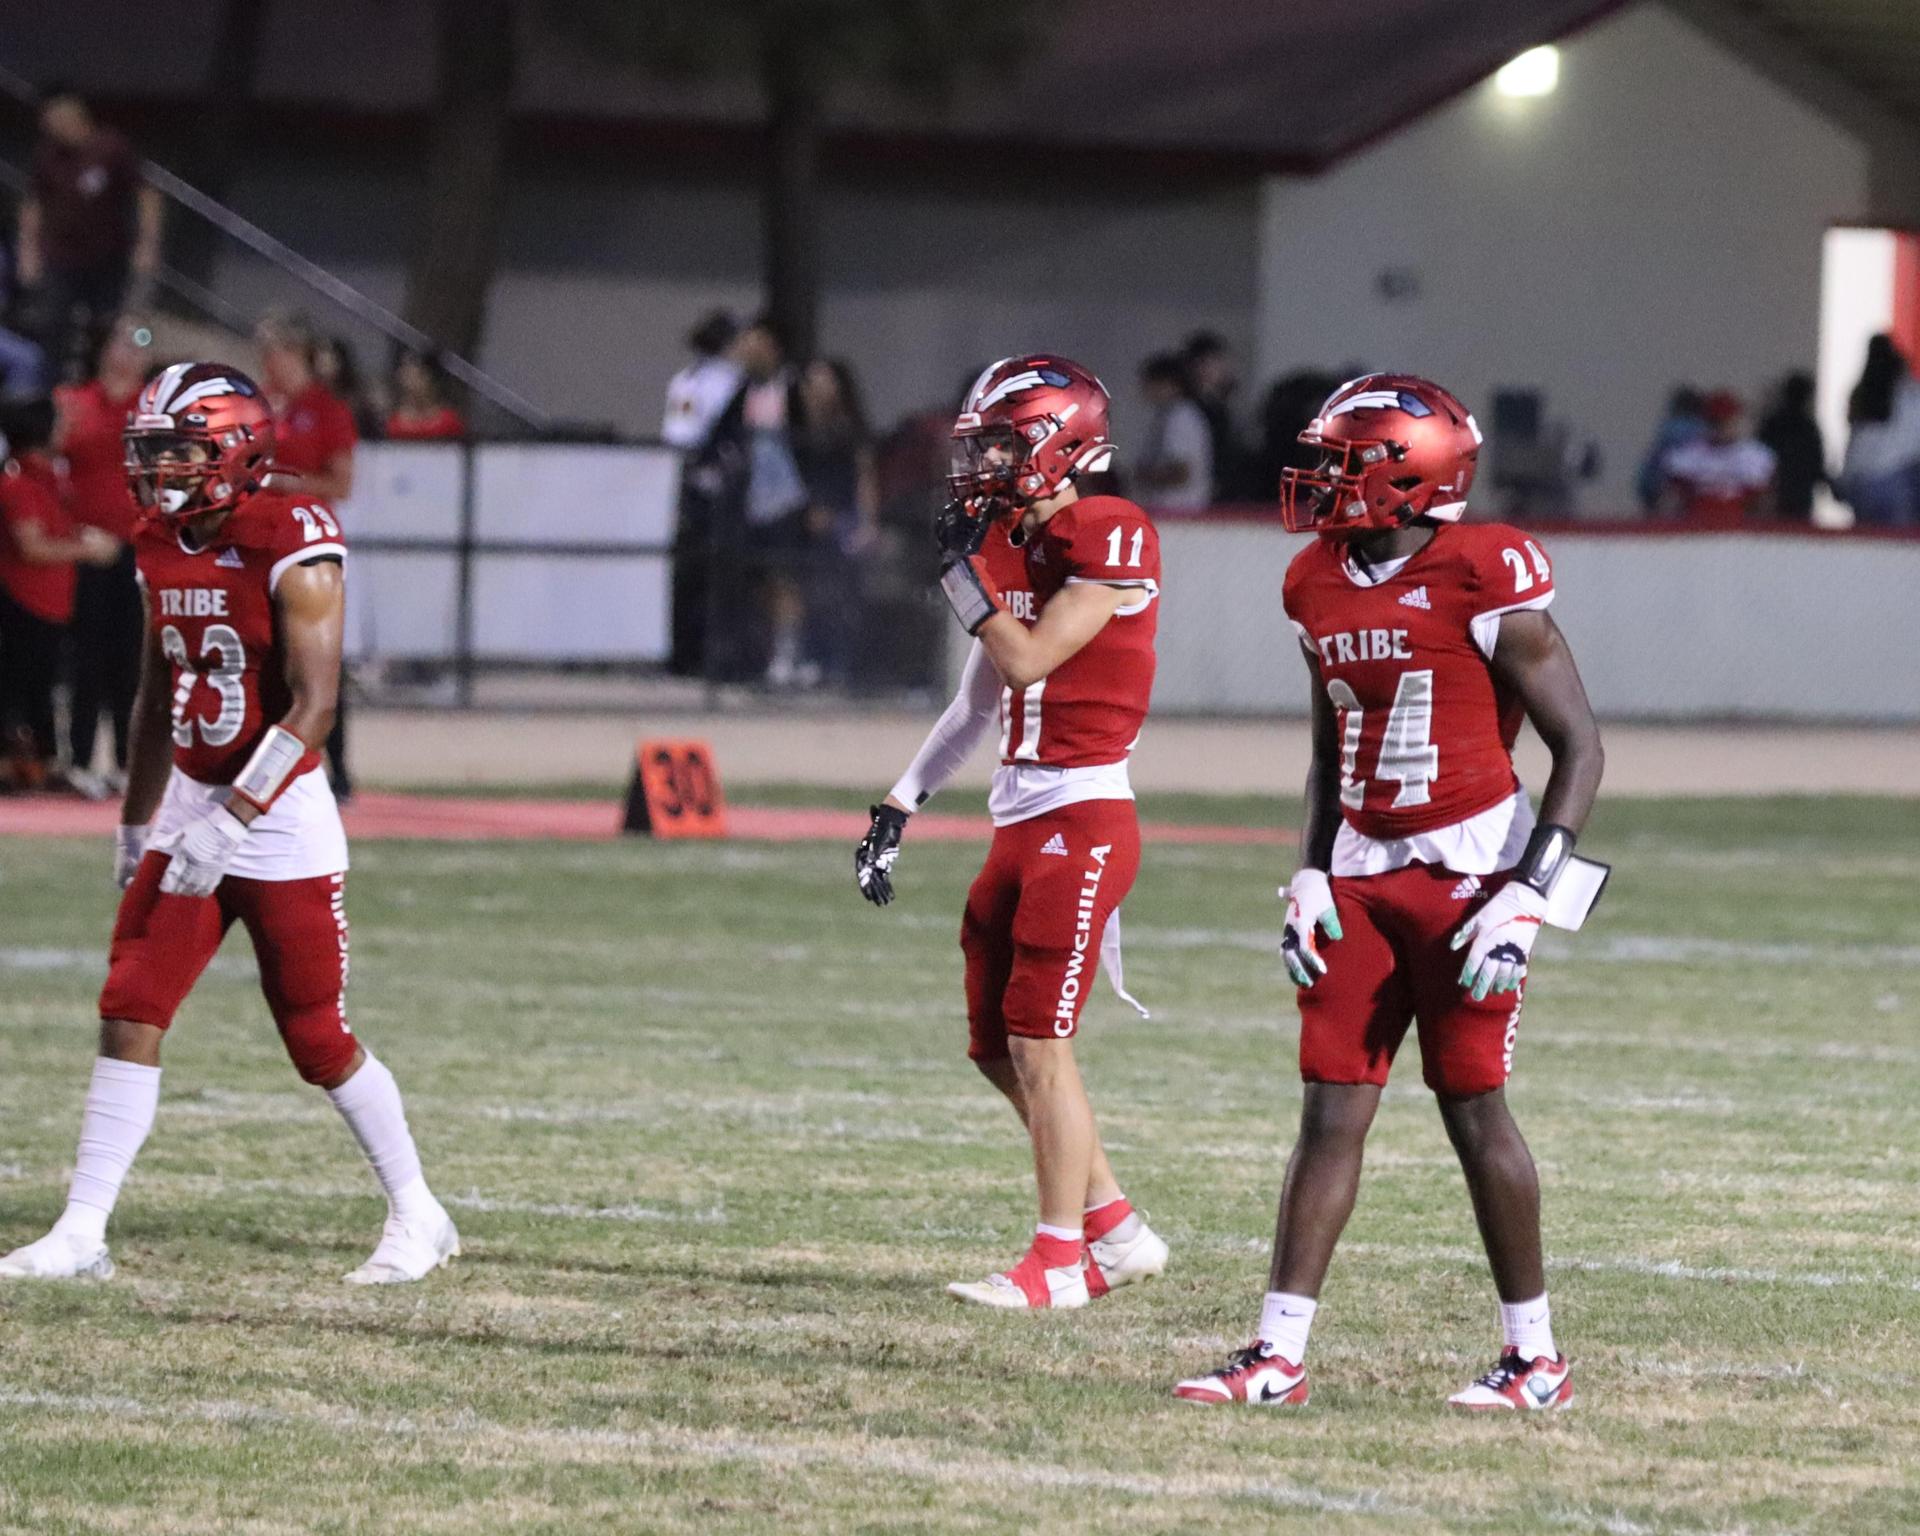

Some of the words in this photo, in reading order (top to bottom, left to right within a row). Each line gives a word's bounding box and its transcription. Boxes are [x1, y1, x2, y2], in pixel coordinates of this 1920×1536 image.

[1105, 525, 1143, 567] 11
[1501, 539, 1550, 594] 24
[159, 589, 229, 617] TRIBE
[997, 590, 1038, 621] IBE
[1318, 629, 1412, 666] TRIBE
[1053, 843, 1112, 1038] CHOWCHILLA
